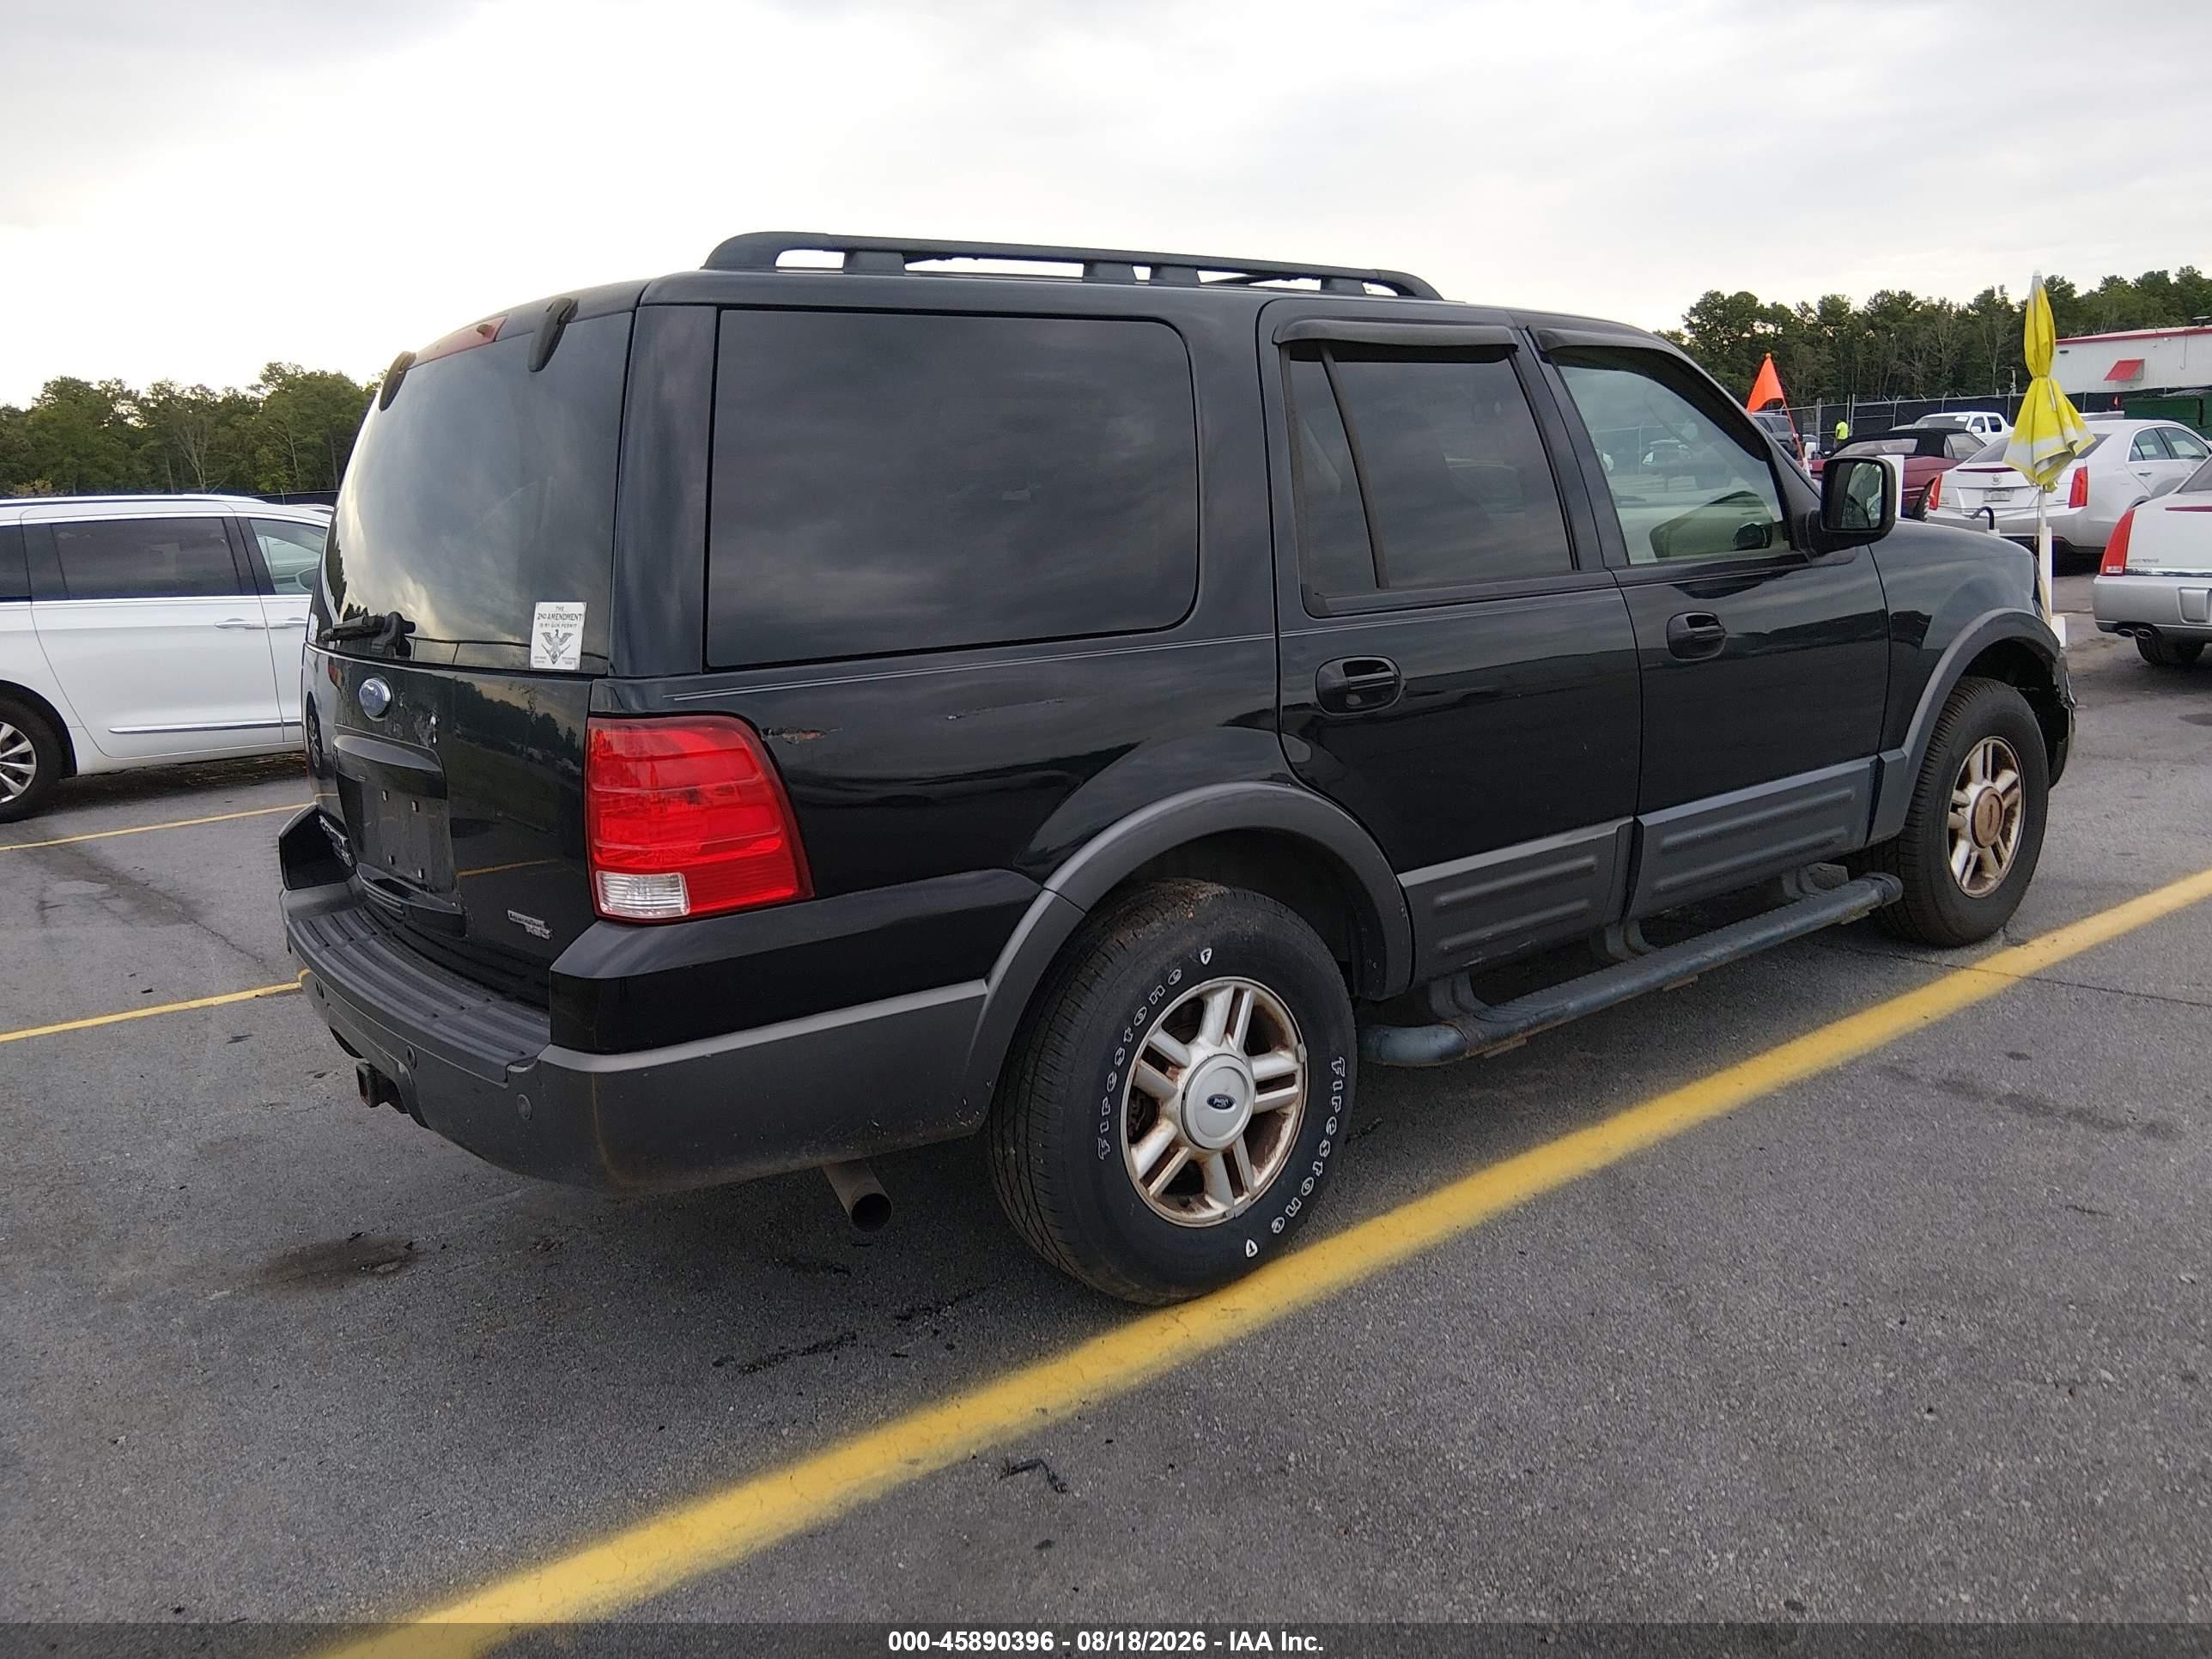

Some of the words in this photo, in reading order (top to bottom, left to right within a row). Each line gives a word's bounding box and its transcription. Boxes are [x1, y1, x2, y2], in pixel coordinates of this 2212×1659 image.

[547, 612, 583, 622] AMENDMENT
[1097, 969, 1182, 1160] Firestone
[1271, 1056, 1346, 1234] Firestone
